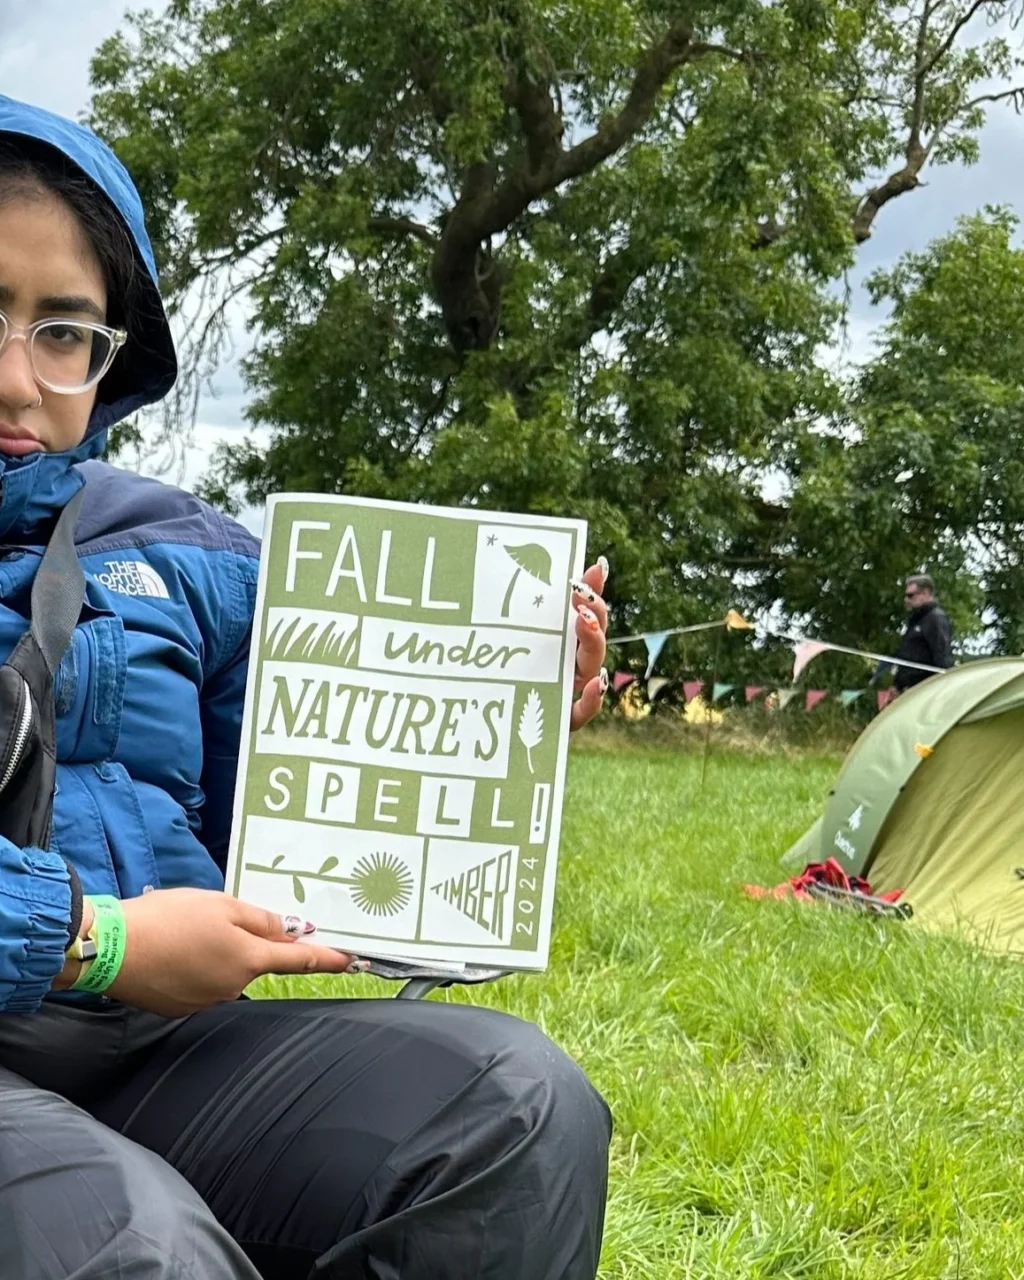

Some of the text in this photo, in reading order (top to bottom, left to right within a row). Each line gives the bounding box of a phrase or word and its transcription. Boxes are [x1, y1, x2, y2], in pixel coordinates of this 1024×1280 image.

[104, 560, 137, 575] THE
[285, 520, 460, 610] FALL
[384, 630, 531, 669] under
[261, 675, 505, 762] NATURE'S
[430, 850, 512, 941] TIMBER
[516, 856, 539, 936] 2024
